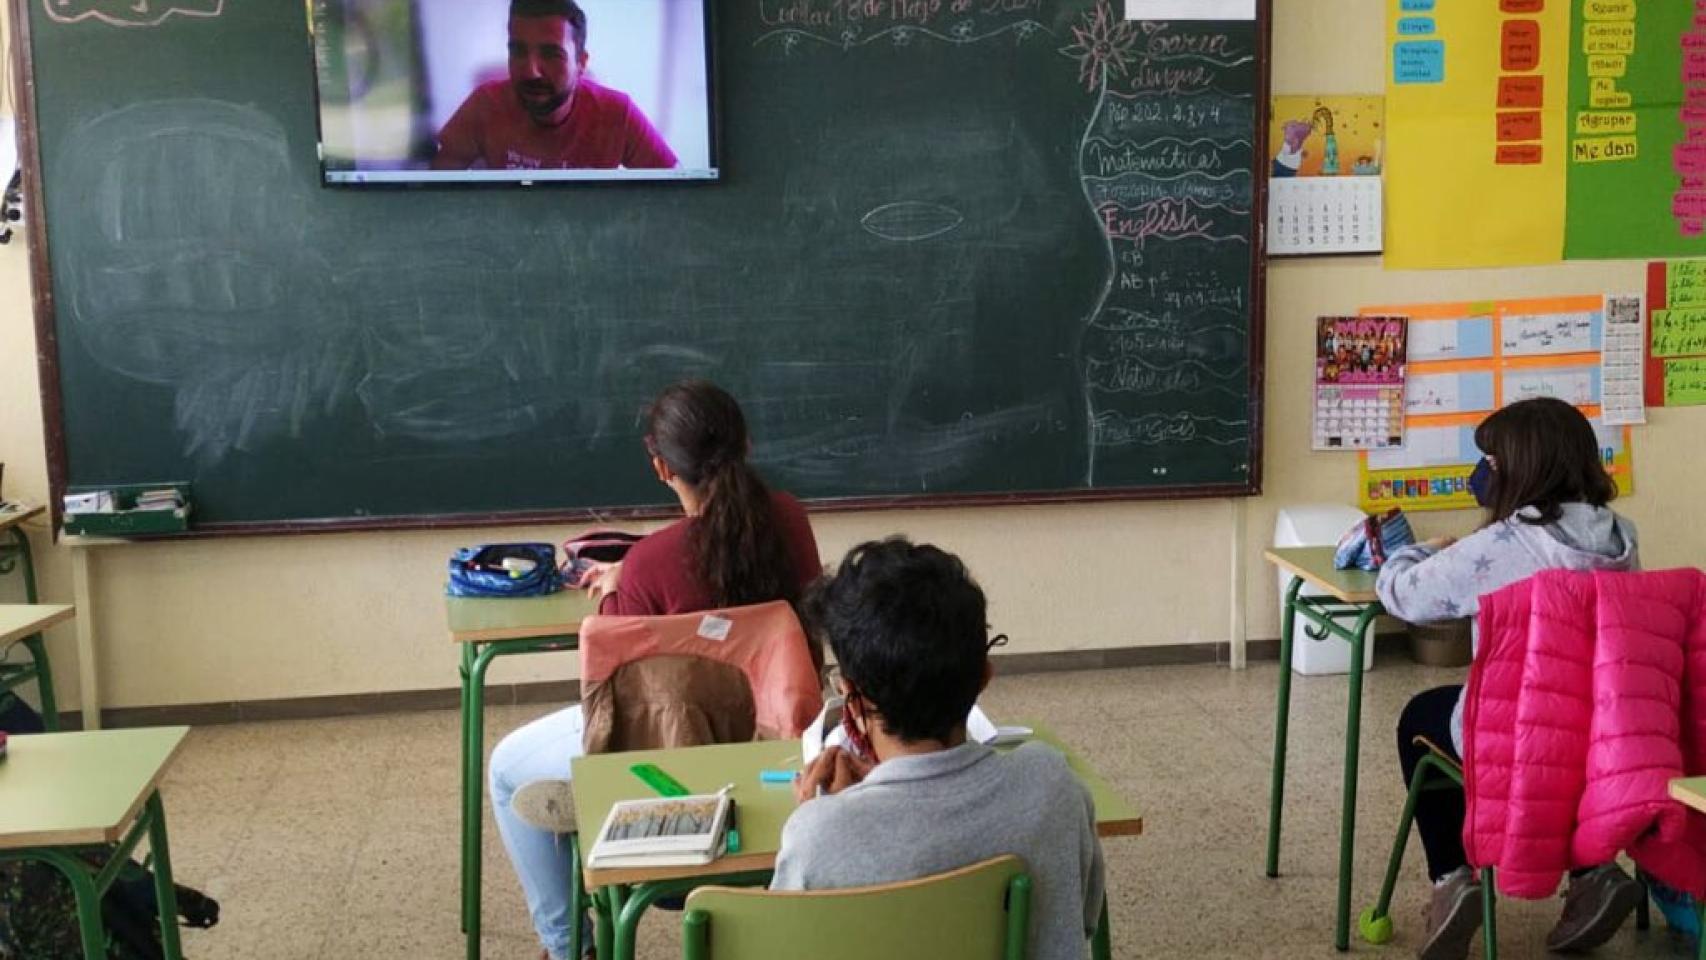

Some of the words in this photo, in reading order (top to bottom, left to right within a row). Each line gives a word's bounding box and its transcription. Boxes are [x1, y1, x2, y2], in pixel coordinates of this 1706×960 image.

[1580, 113, 1633, 129] Agrupar
[1575, 143, 1599, 160] Me
[1603, 140, 1635, 157] dan
[1103, 198, 1214, 250] English
